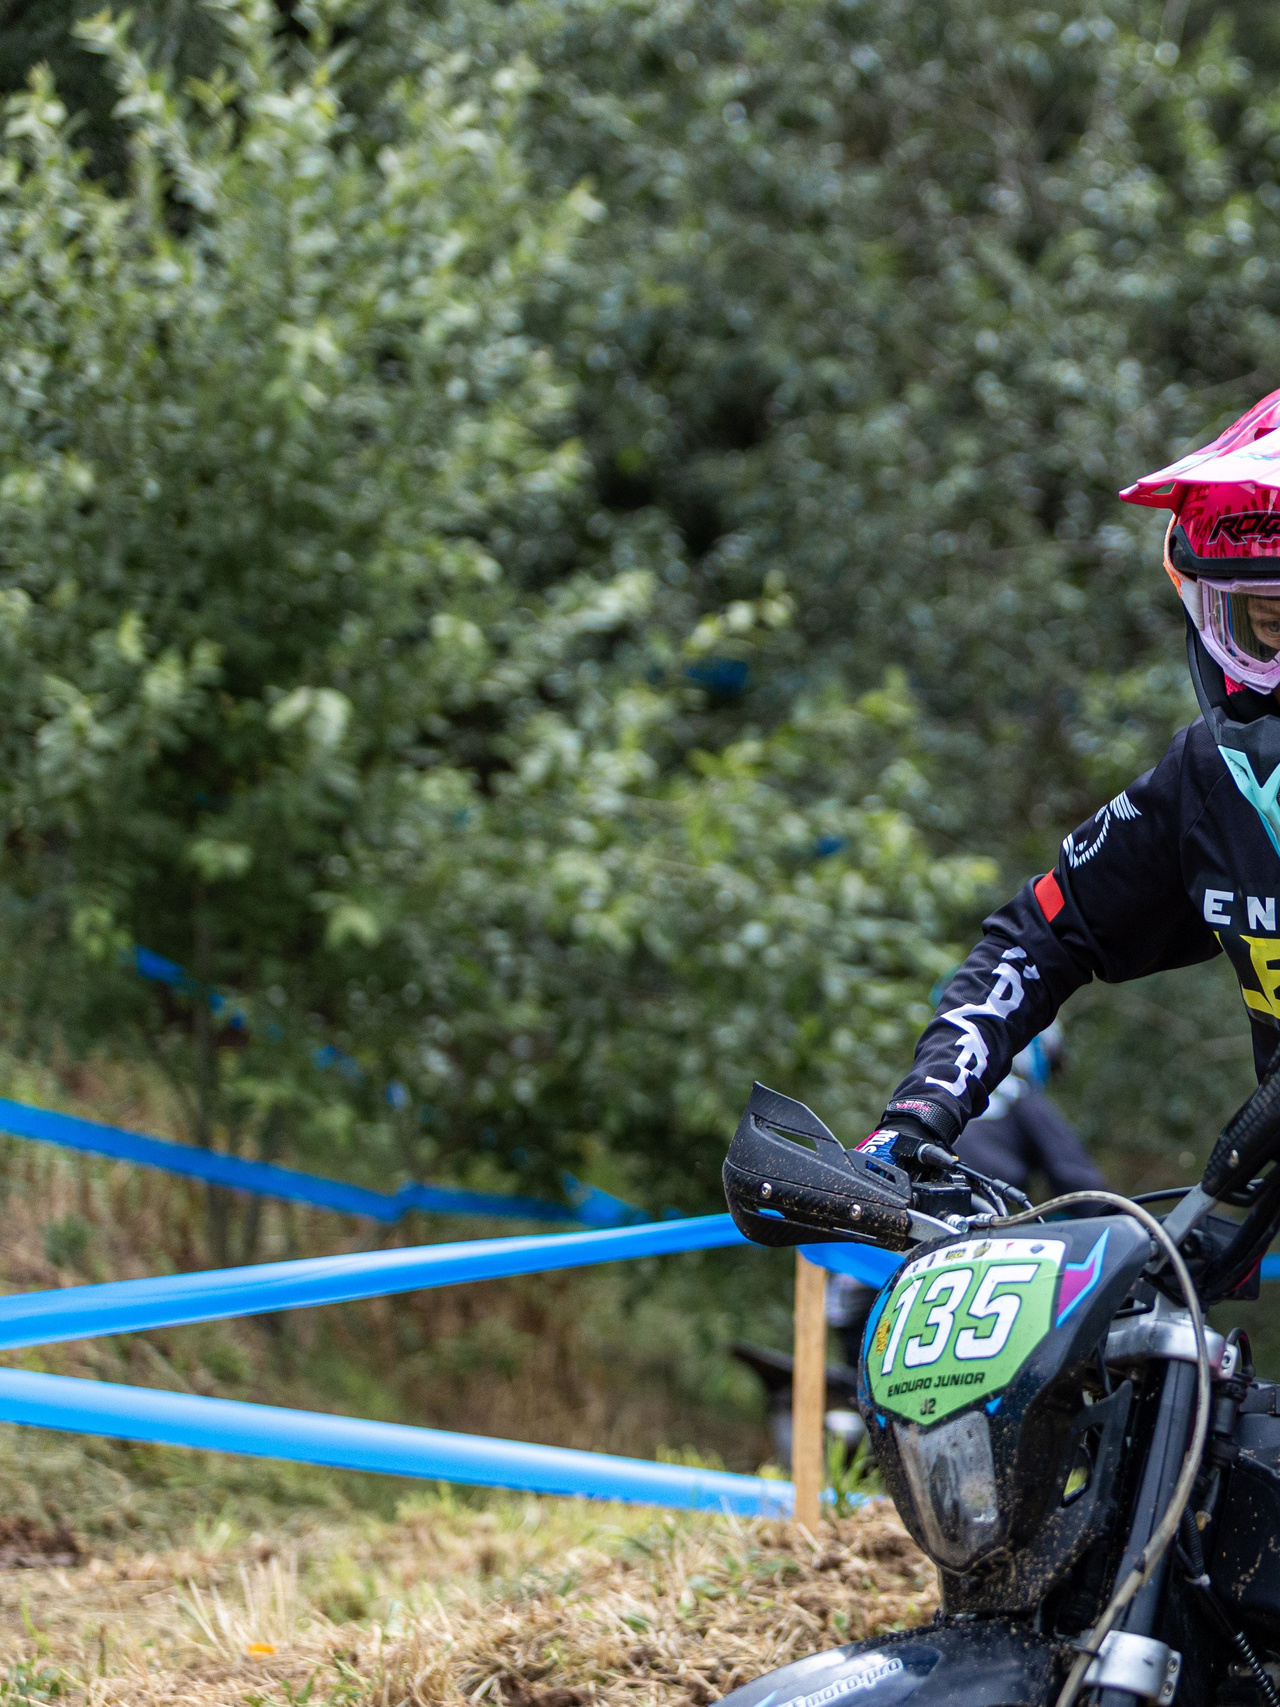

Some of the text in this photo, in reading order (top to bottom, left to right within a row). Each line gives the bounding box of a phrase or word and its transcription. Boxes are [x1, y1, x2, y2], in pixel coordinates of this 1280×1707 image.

[880, 1262, 1041, 1377] 135
[887, 1371, 985, 1397] ENDURO JUNIOR
[920, 1398, 936, 1415] J2
